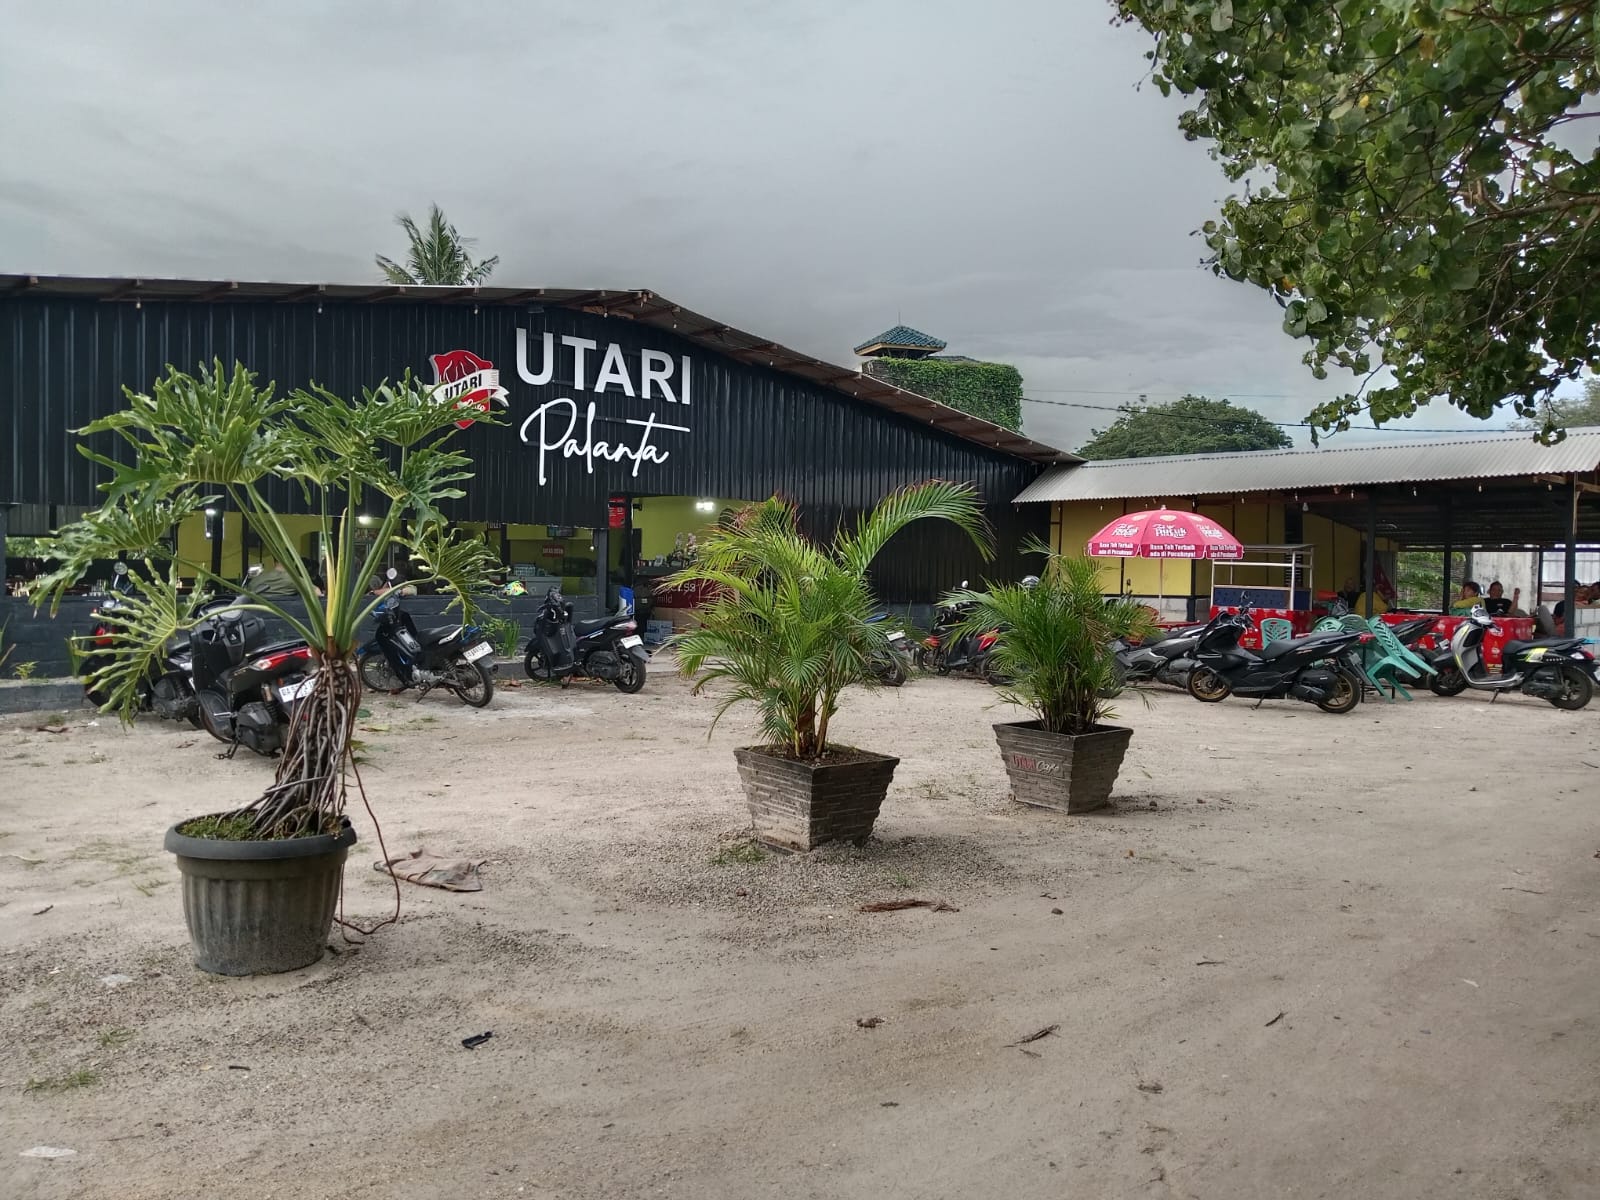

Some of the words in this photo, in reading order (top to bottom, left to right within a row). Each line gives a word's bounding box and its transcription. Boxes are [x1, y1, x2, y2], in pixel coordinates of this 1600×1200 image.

[445, 373, 482, 399] UTARI
[516, 327, 691, 405] UTARI
[519, 397, 691, 486] Palanta
